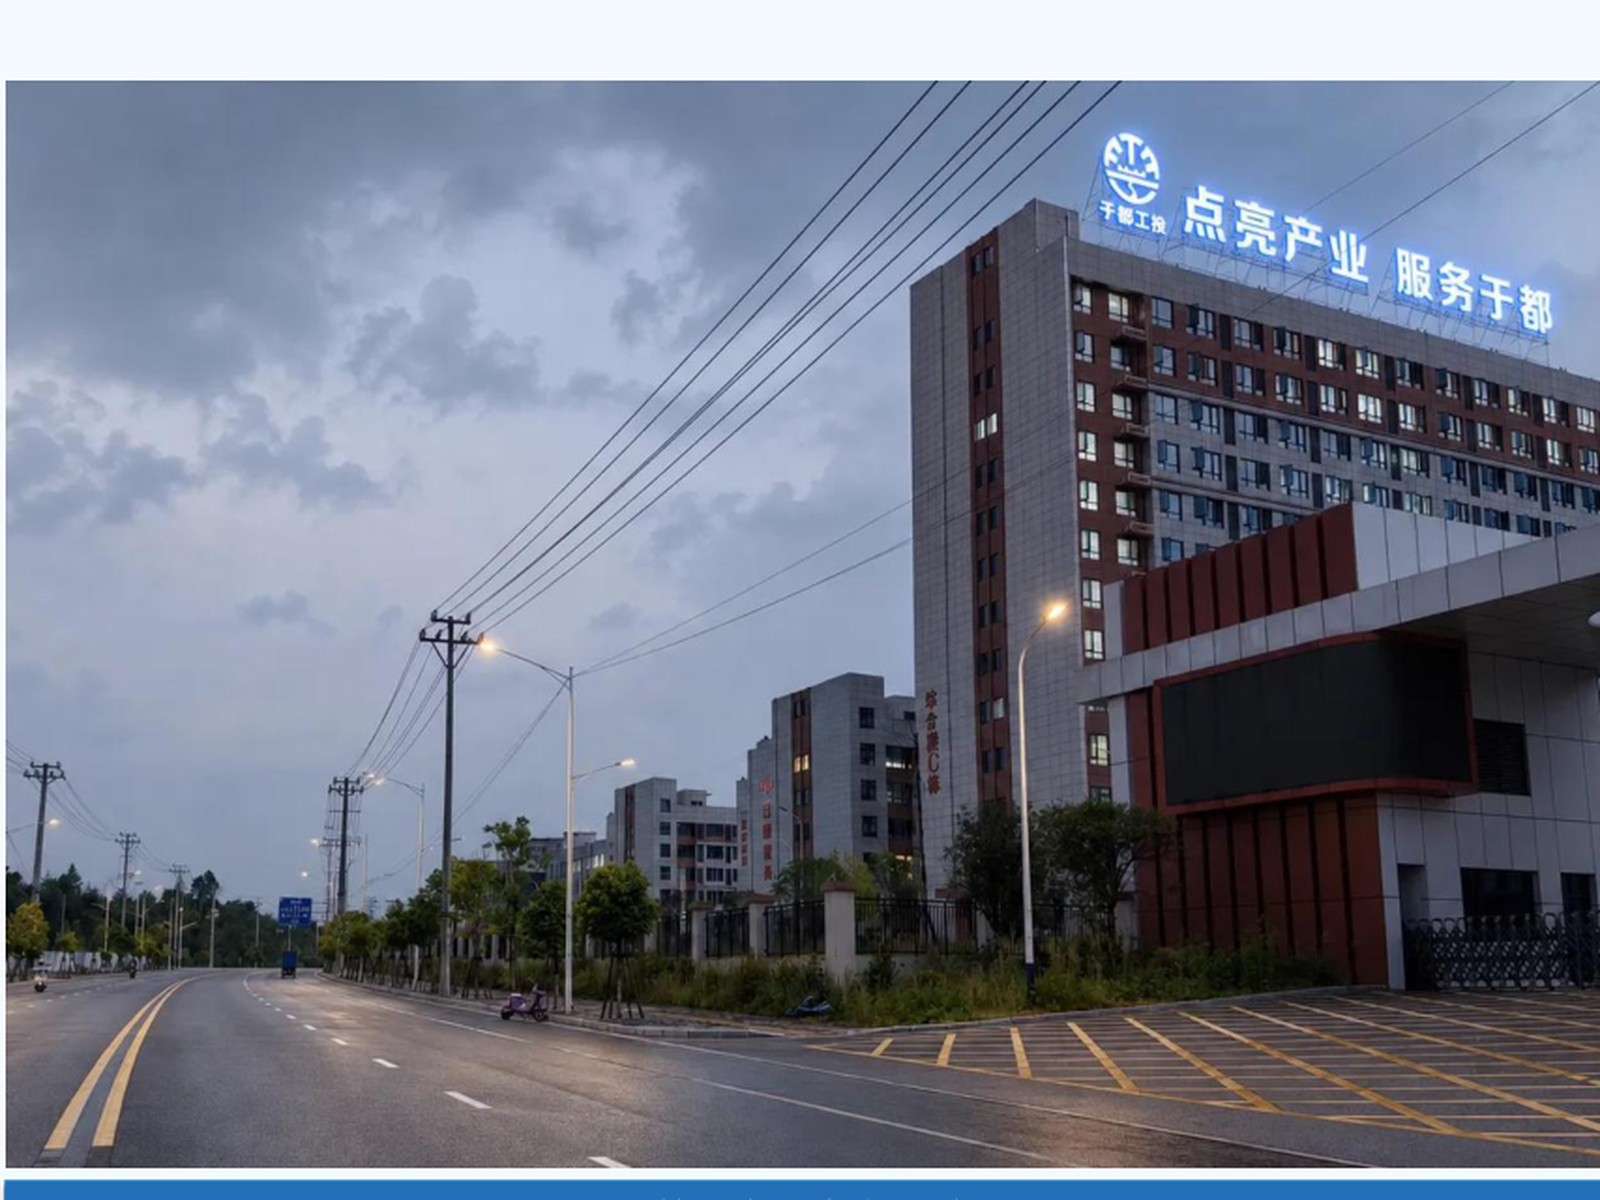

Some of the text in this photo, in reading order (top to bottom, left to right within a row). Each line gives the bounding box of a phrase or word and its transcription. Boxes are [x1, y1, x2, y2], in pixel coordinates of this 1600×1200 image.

[1185, 185, 1554, 334] 点亮产业 服务于都
